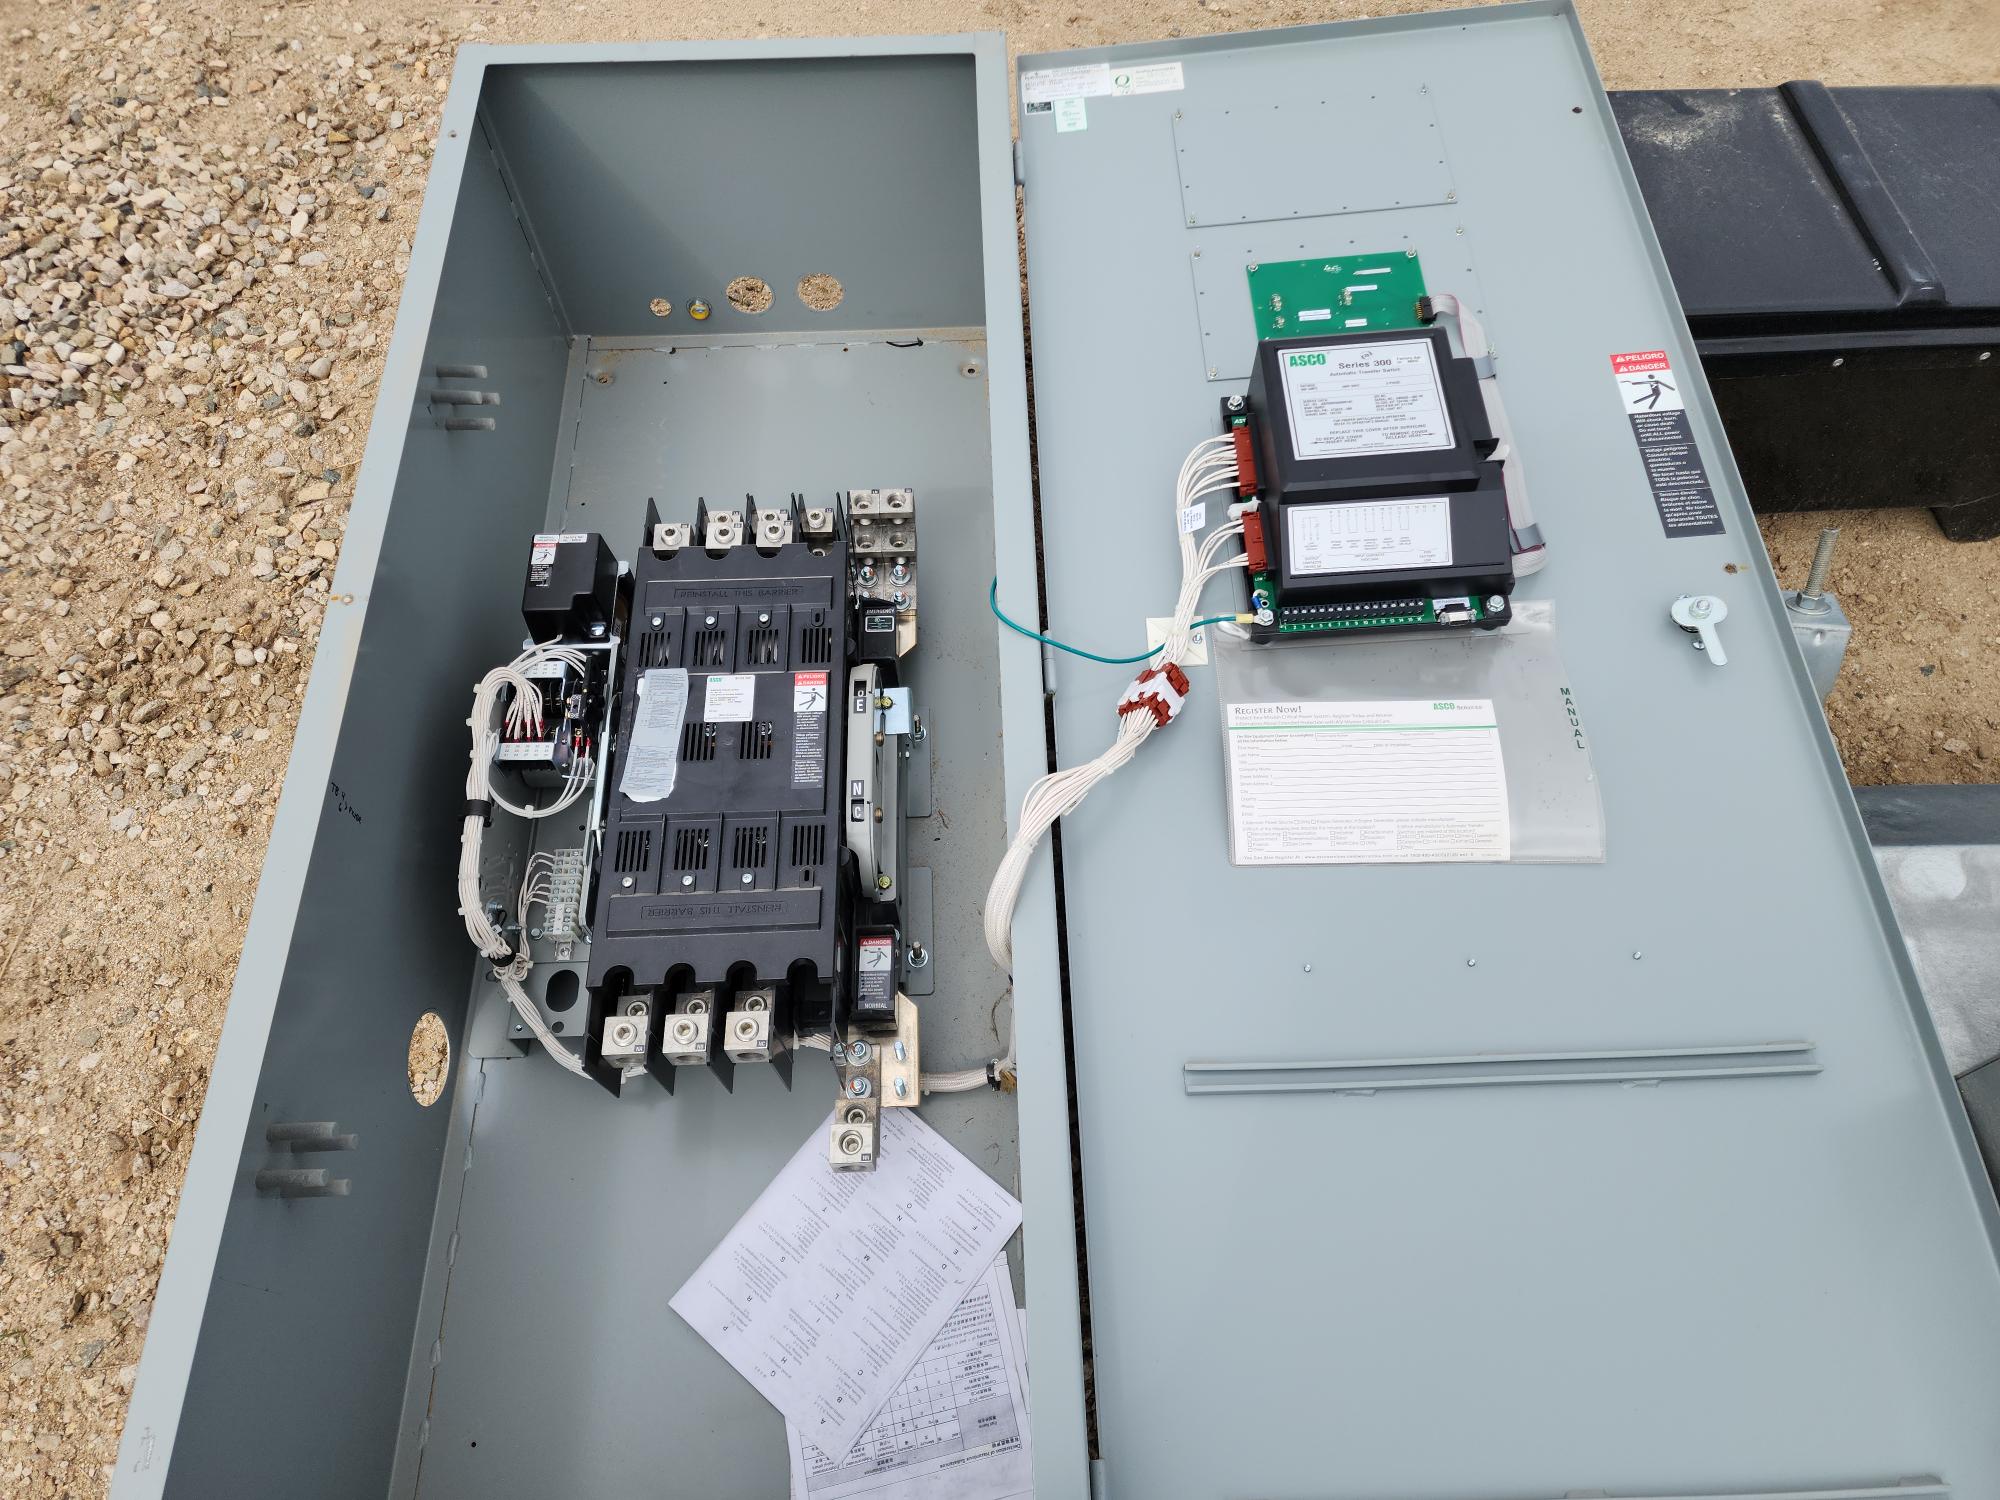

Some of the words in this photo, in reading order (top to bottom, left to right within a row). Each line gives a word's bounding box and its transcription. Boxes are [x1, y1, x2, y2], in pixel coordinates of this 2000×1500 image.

[1289, 354, 1327, 367] ASCO
[1625, 353, 1665, 362] PELIGRO
[1338, 361, 1371, 370] Series
[1373, 359, 1393, 367] 300
[1628, 362, 1667, 371] DANGER
[680, 590, 729, 599] REINSTALL
[734, 588, 754, 597] THIS
[757, 587, 801, 597] BARRIER
[856, 699, 864, 711] E
[1433, 702, 1455, 711] ASCO
[1560, 687, 1585, 749] MANUAL
[852, 782, 862, 796] N
[854, 806, 861, 819] C
[648, 907, 694, 917] BARRIER
[701, 906, 721, 915] THIS
[727, 903, 783, 914] REINSTALL
